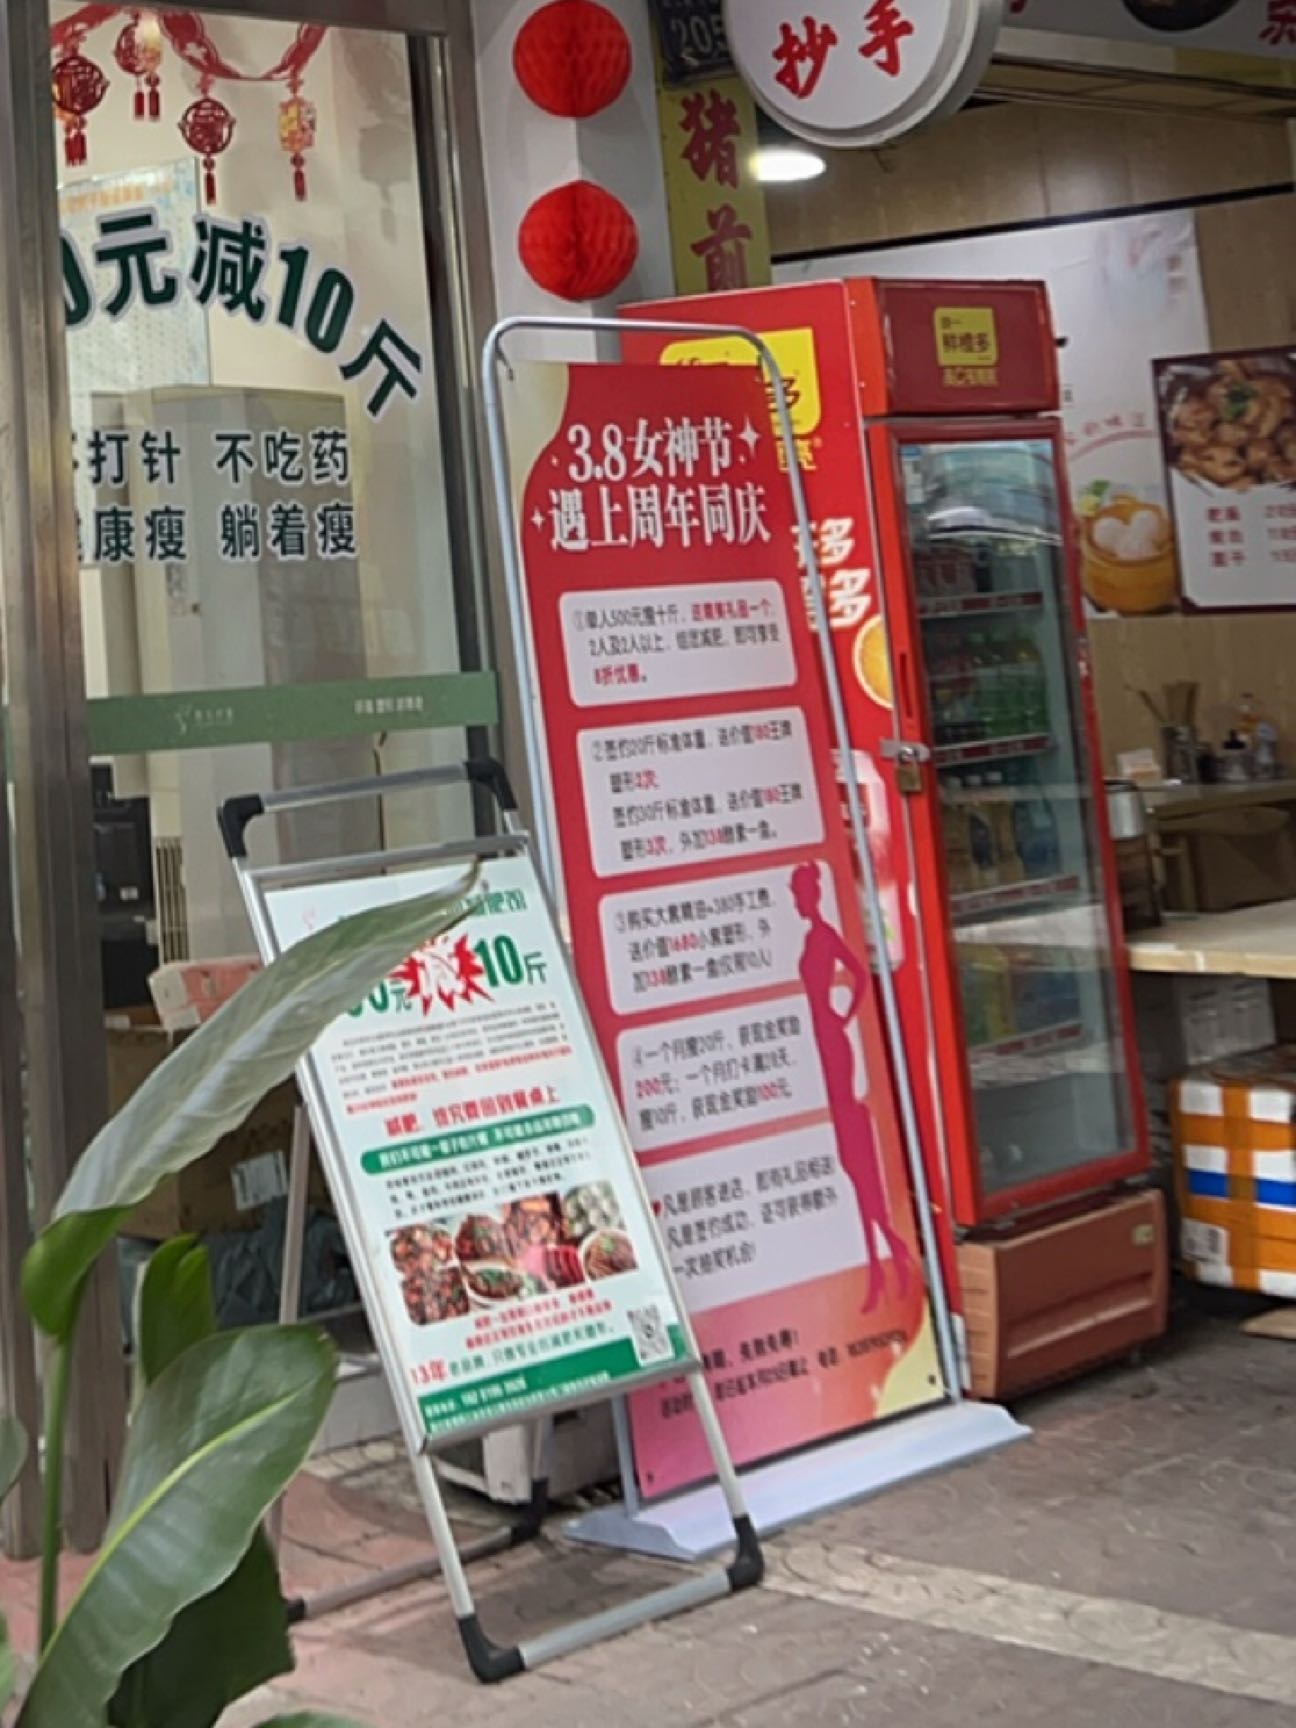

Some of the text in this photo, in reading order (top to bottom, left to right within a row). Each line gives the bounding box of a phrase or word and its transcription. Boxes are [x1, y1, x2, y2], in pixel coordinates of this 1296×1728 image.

[71, 430, 348, 484] 打针 不吃药
[567, 417, 734, 483] 3.8女神节
[76, 503, 356, 561] 康瘦 躺着瘦
[549, 481, 772, 552] 遇上周年同庆
